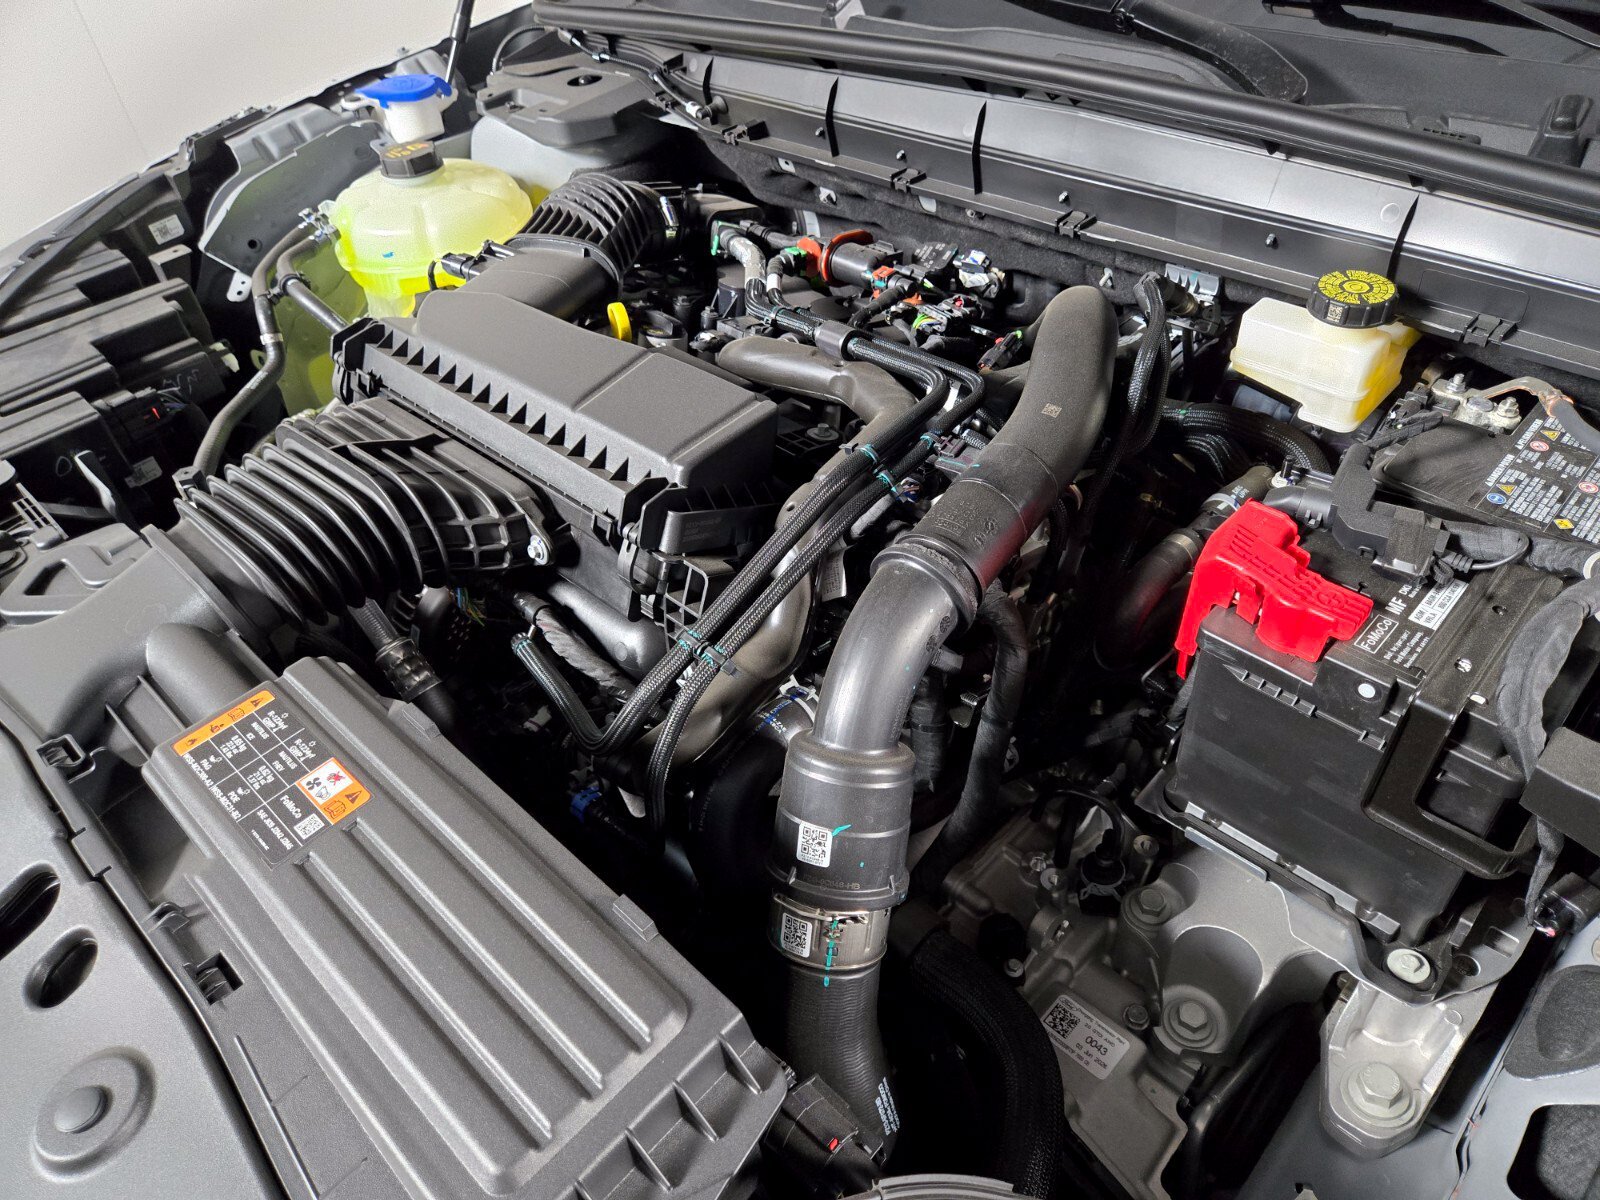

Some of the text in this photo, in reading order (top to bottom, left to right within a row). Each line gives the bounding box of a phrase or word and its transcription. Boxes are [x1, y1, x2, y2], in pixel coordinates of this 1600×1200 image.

[1385, 597, 1406, 615] MF
[1414, 610, 1424, 622] AGM
[1361, 619, 1392, 650] FoMoCo
[200, 759, 212, 770] PAG
[227, 791, 240, 803] POE
[280, 795, 302, 818] FoMoCo
[1084, 1049, 1093, 1058] Jun
[1085, 1036, 1108, 1056] 0043
